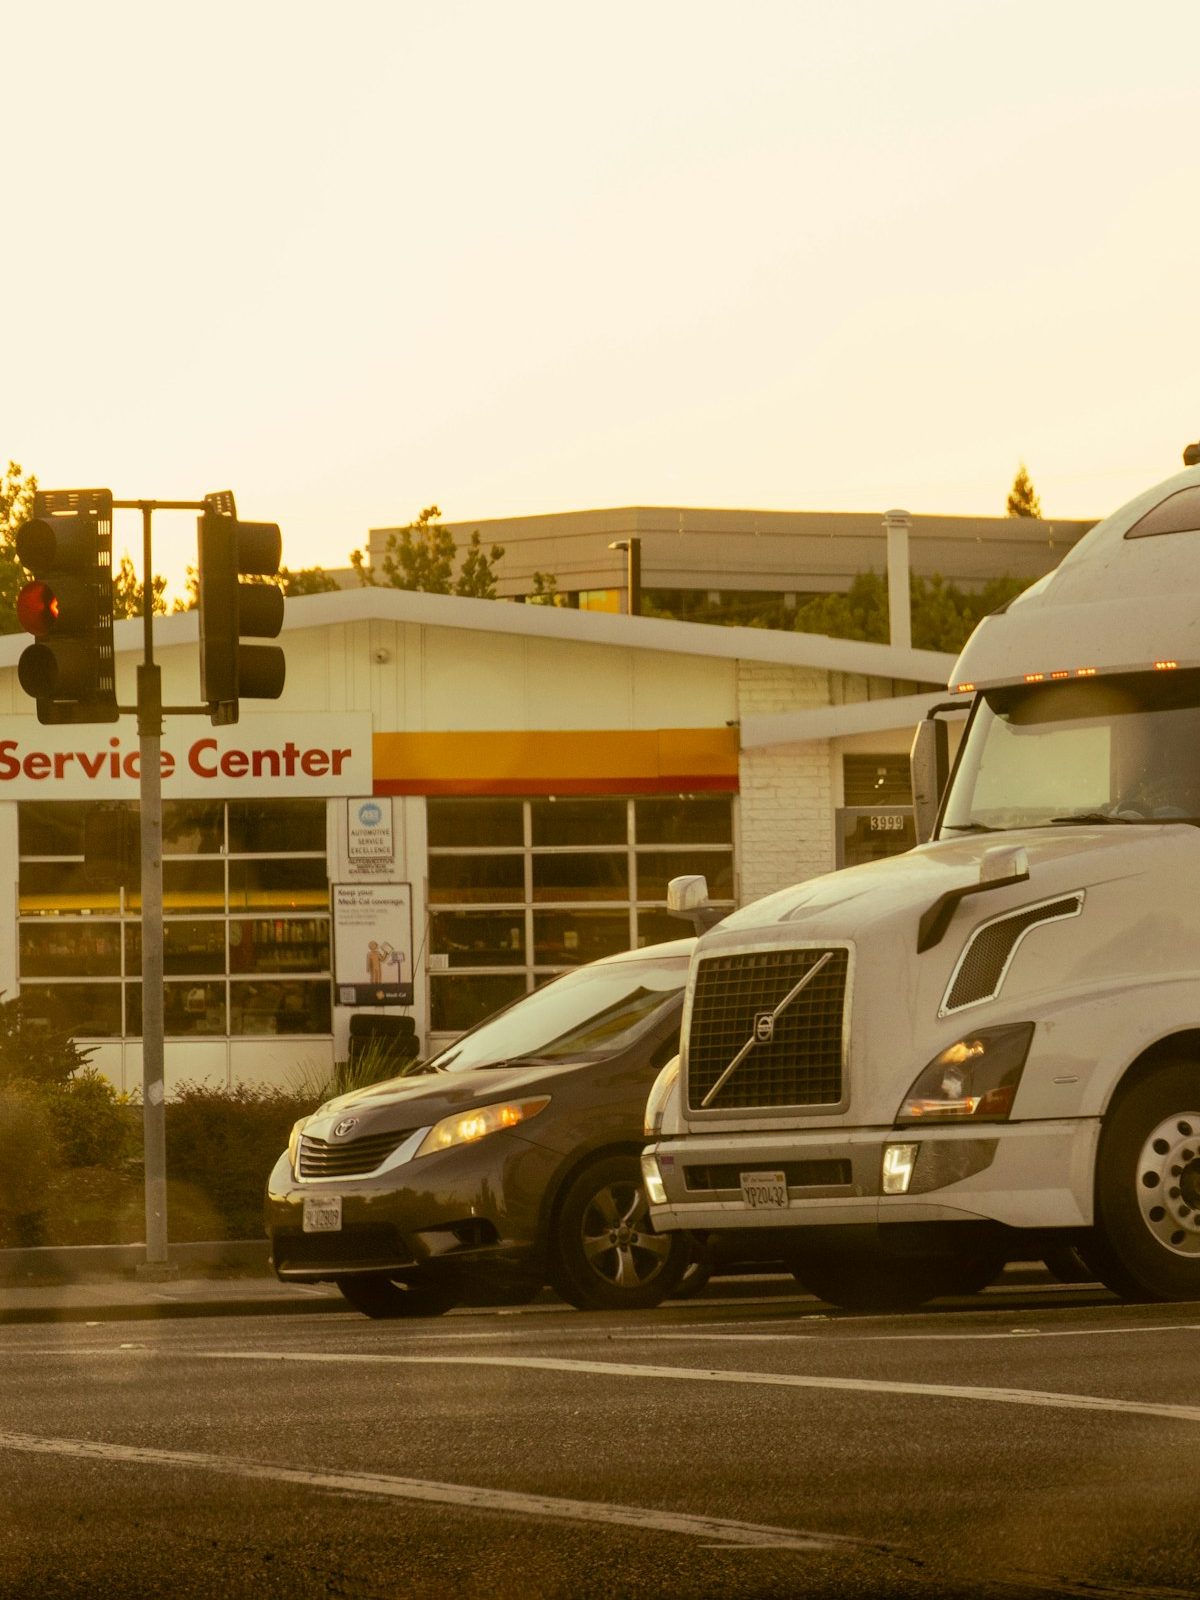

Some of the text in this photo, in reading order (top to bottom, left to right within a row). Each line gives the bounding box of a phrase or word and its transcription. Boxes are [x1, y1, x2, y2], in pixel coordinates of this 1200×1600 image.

[0, 737, 352, 780] Service Center
[871, 816, 903, 830] 3999
